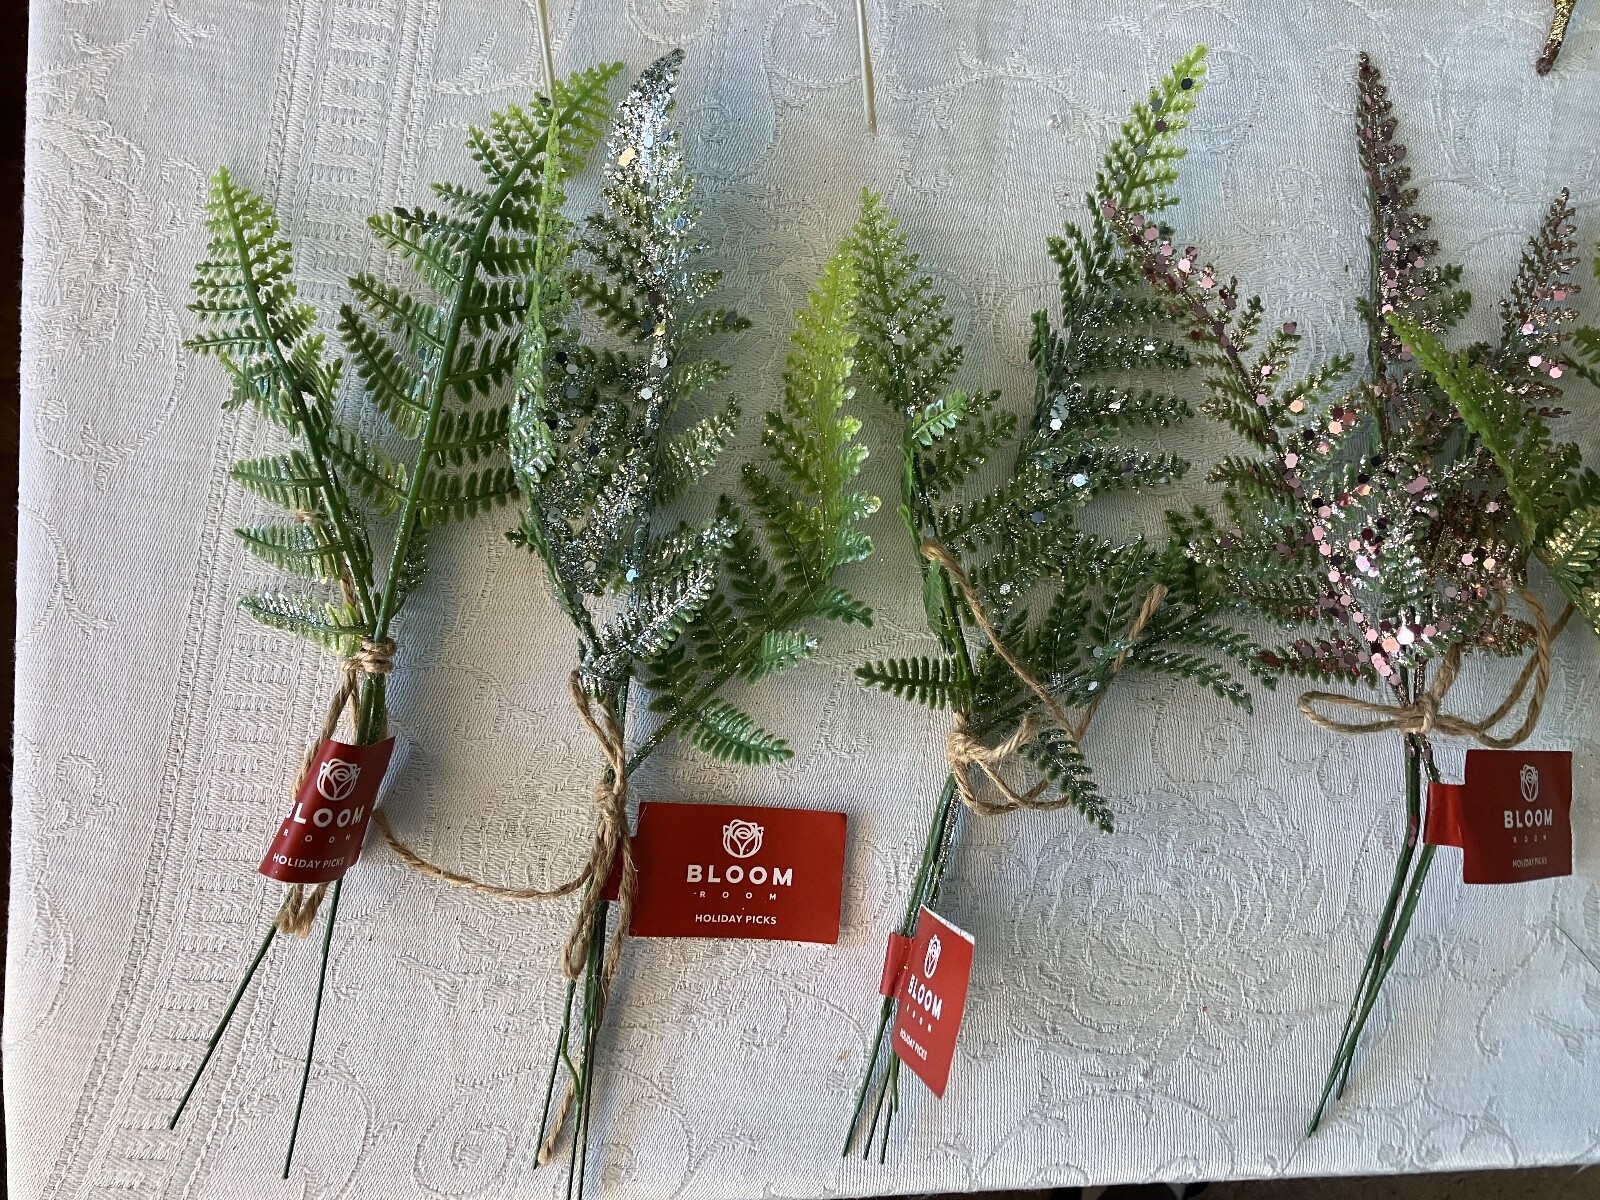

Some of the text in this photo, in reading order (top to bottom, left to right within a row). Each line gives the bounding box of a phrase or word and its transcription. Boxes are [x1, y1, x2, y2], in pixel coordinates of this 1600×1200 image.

[1503, 808, 1553, 829] BLOOM
[282, 828, 351, 844] ROOM
[272, 852, 345, 869] HOLIDAY PICKS
[686, 864, 793, 887] BLOOM
[699, 890, 777, 901] ROOM
[694, 914, 777, 925] HOLIDAY PICKS
[907, 973, 943, 1021] BLOOM
